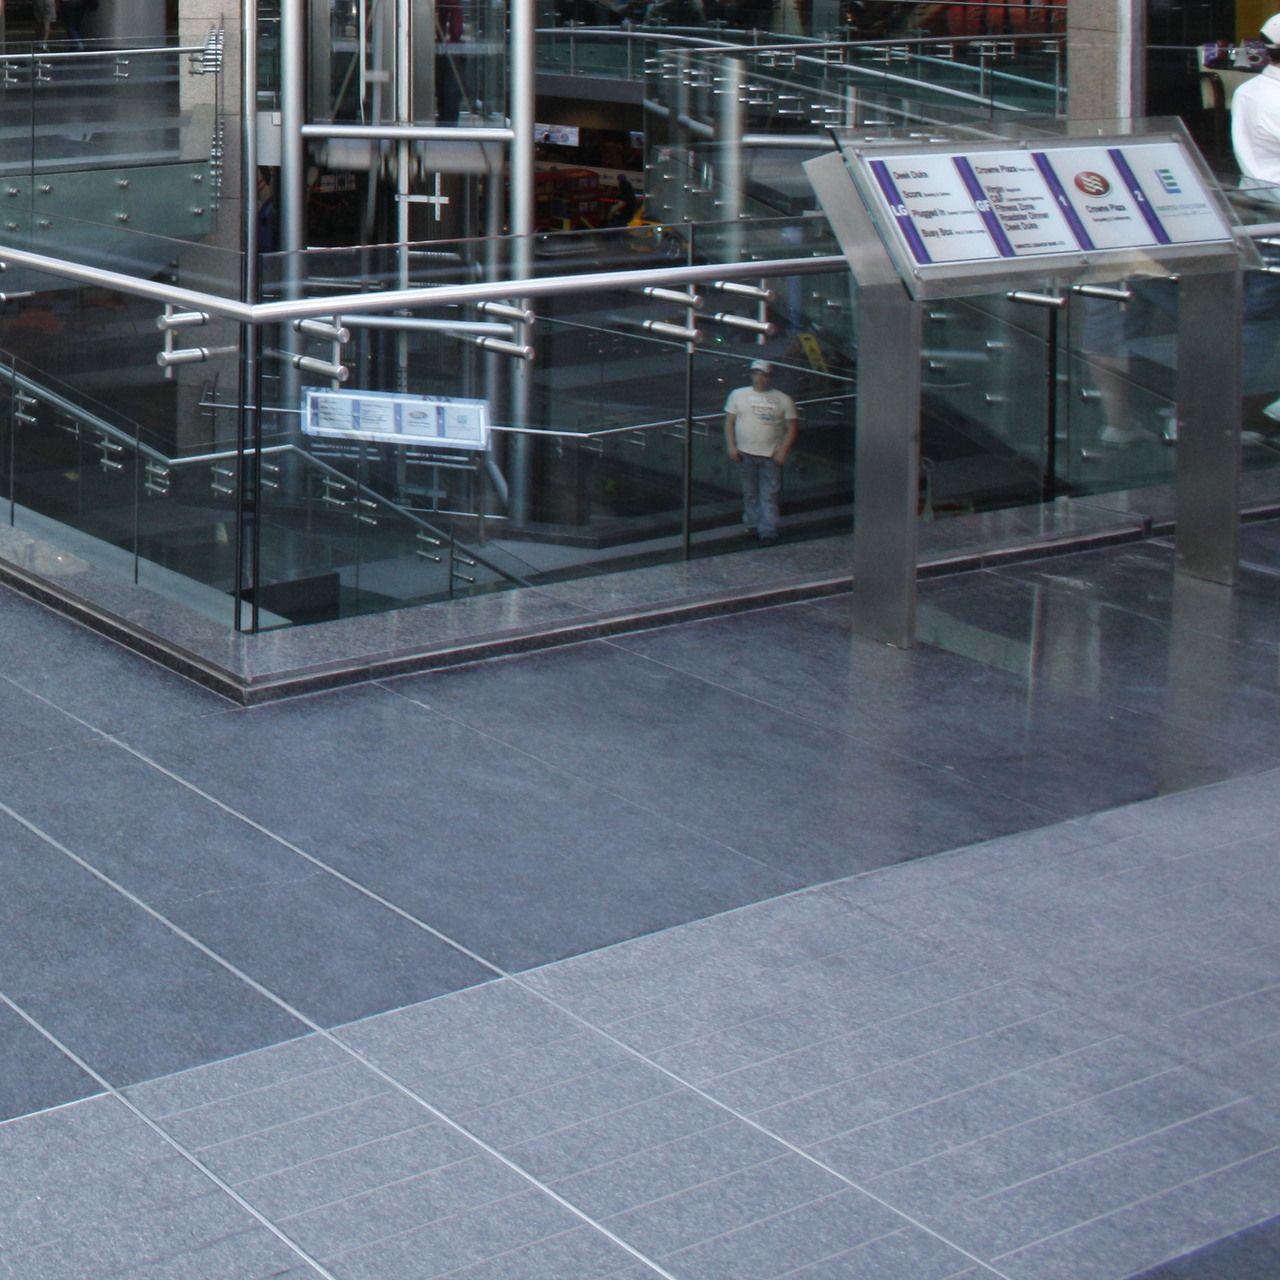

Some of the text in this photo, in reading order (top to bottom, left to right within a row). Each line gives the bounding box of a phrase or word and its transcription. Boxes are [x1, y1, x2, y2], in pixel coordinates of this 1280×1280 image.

[1134, 190, 1145, 202] 2
[891, 204, 908, 216] LG
[975, 200, 991, 212] GF
